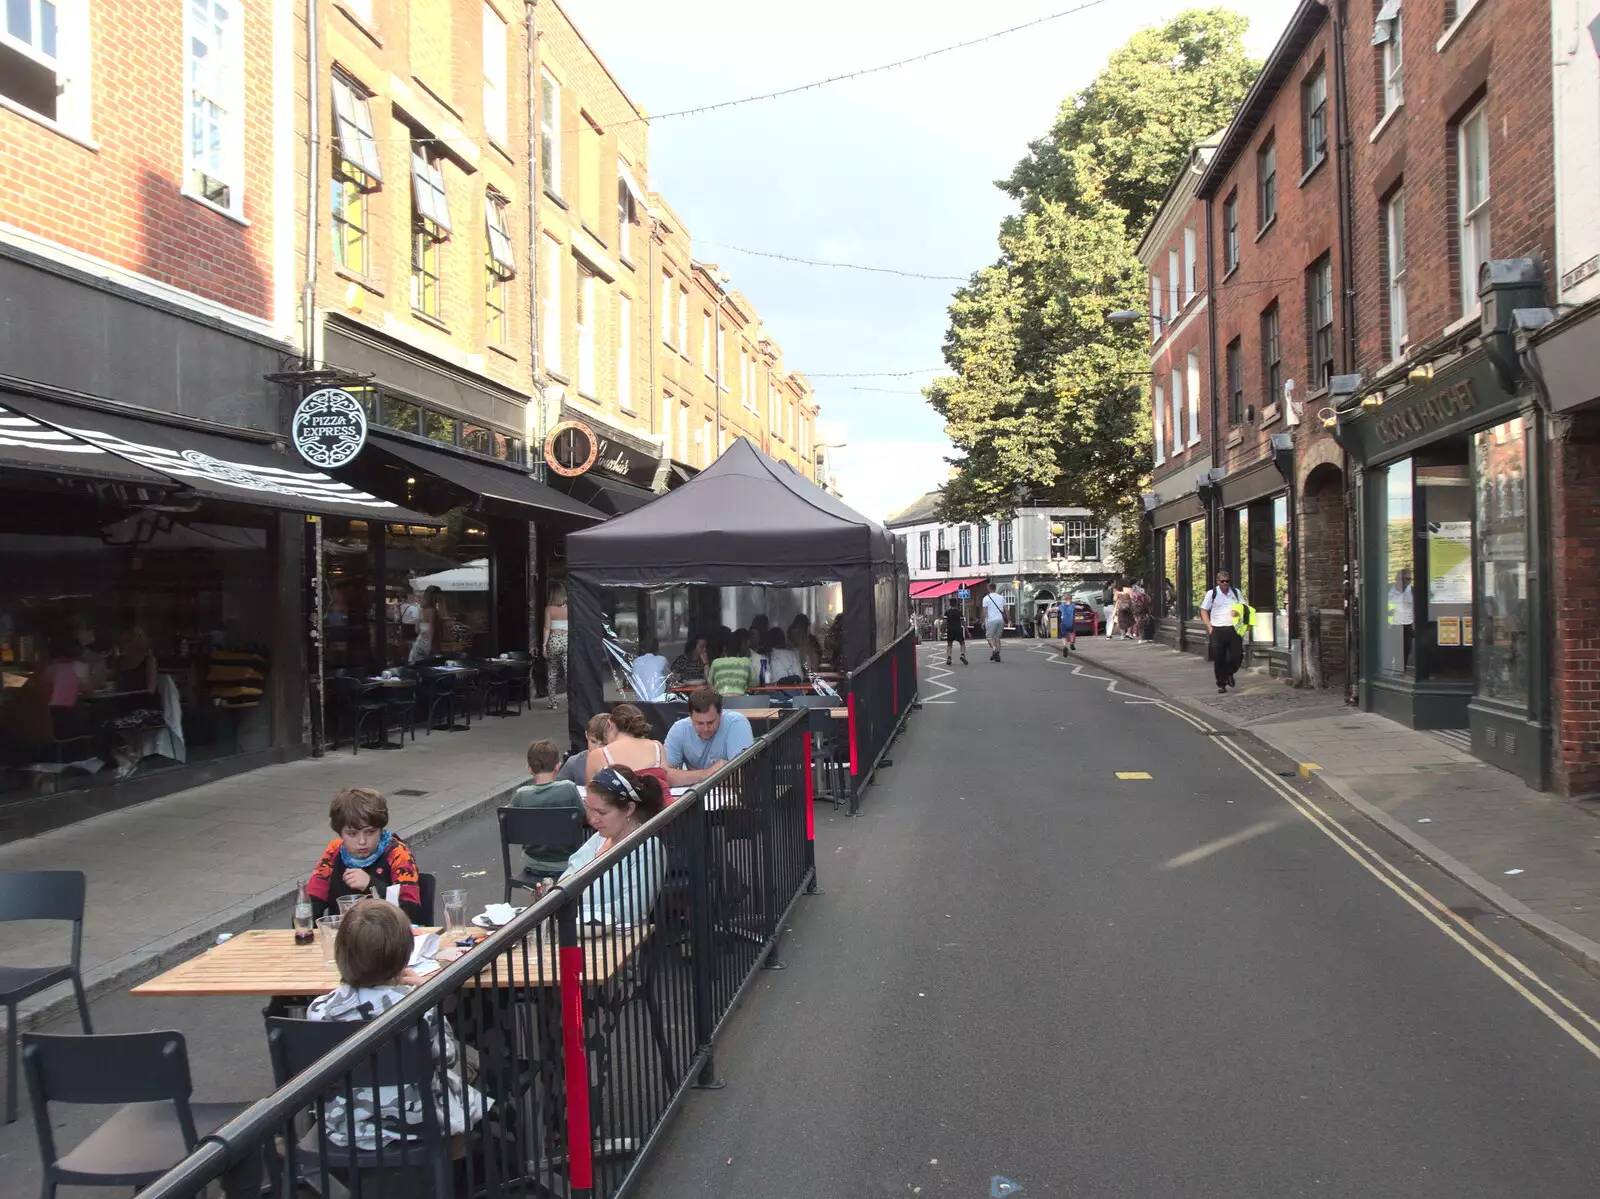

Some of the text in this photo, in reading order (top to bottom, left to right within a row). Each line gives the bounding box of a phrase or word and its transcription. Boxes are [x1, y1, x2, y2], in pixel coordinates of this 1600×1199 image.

[1418, 378, 1476, 427] HATCHET
[312, 415, 346, 426] PIZZA
[303, 426, 356, 437] EXPRESS
